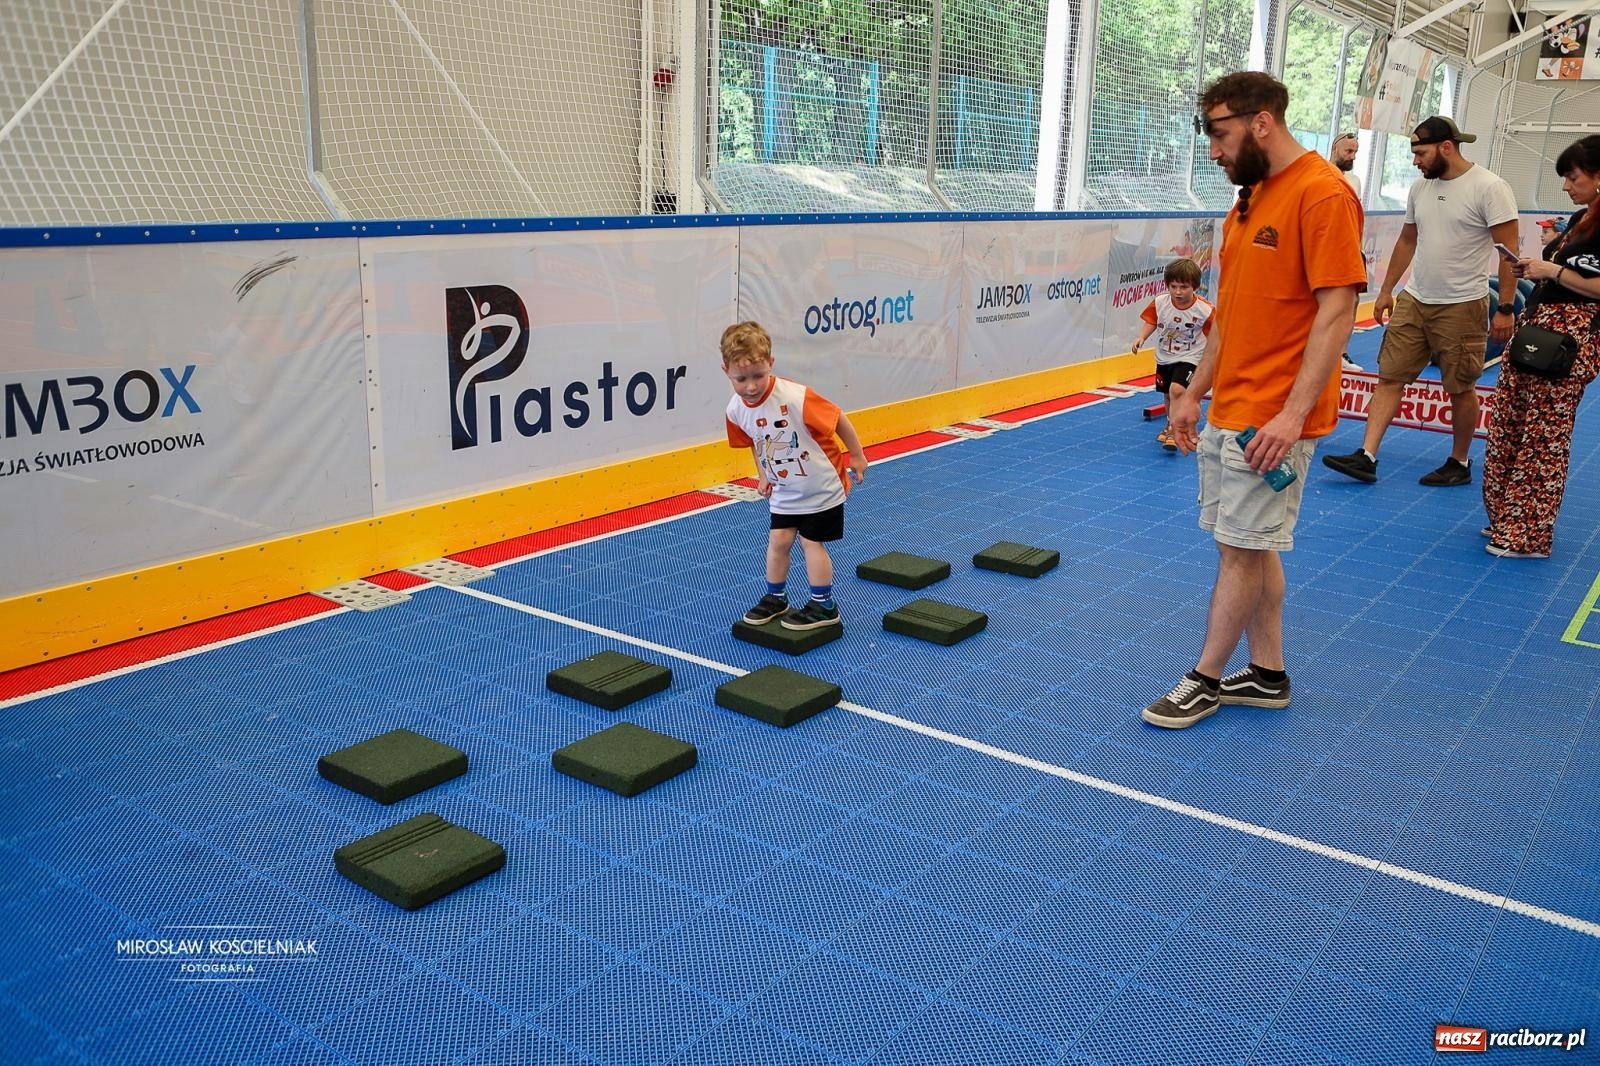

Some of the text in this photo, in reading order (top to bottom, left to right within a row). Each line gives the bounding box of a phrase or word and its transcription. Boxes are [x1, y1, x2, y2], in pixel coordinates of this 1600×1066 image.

[1047, 274, 1101, 303] ostrog.net
[1112, 282, 1142, 308] MOCNE
[804, 289, 915, 338] ostrog.net
[446, 285, 687, 451] Piastor
[0, 365, 202, 439] MBOX
[35, 433, 205, 472] ŚWIATŁOWODOWA
